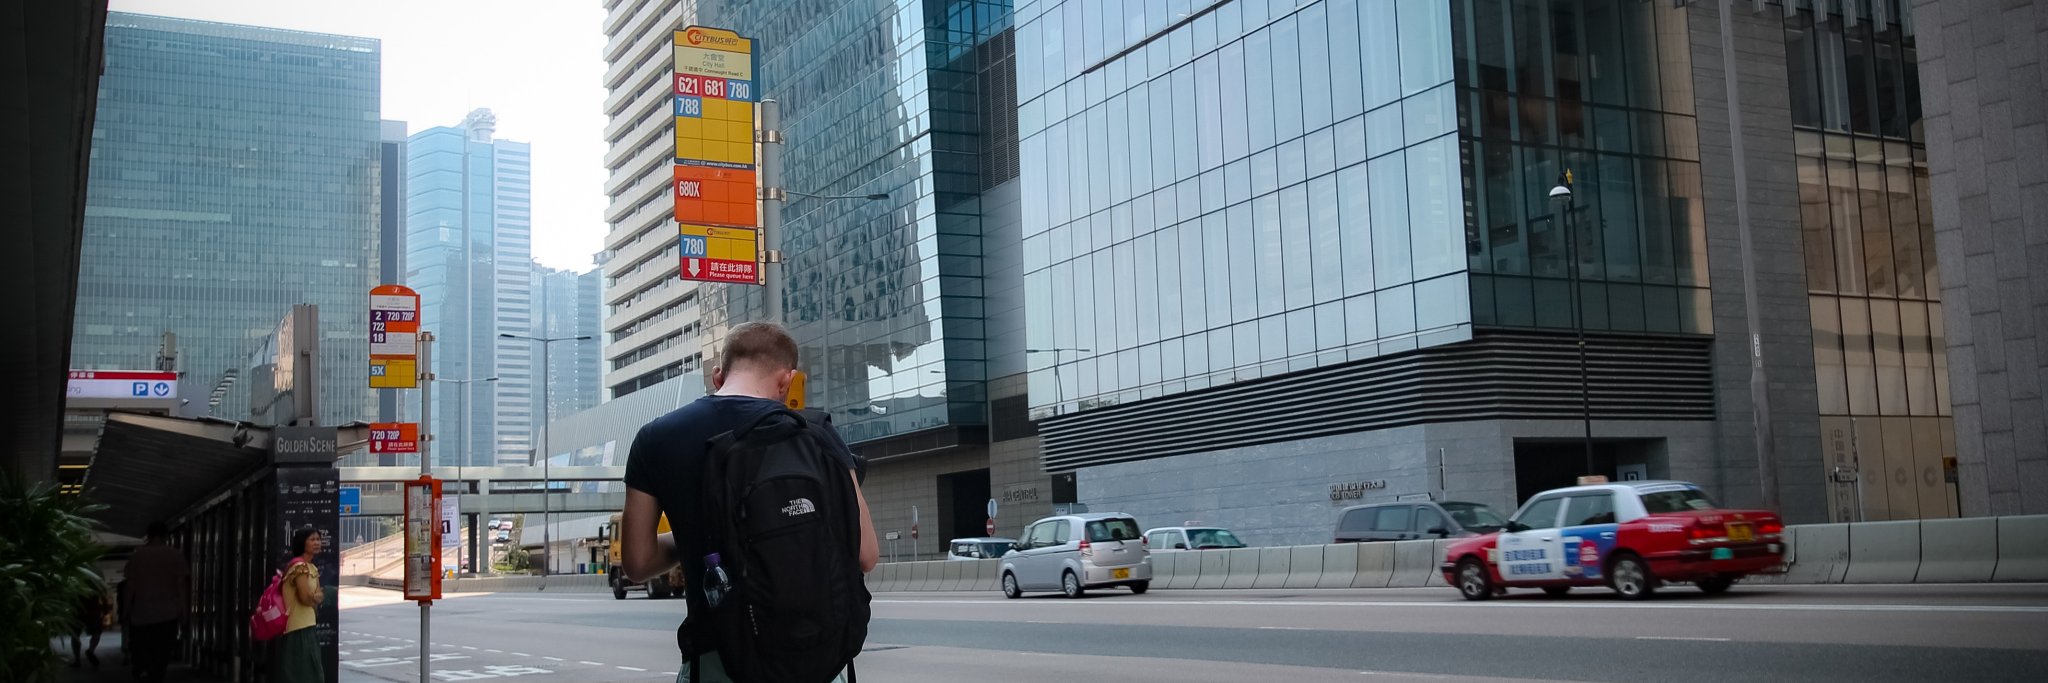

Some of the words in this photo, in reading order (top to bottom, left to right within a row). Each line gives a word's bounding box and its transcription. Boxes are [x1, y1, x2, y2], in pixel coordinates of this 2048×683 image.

[678, 77, 698, 94] 621
[704, 79, 724, 97] 681
[729, 82, 749, 99] 780
[678, 98, 699, 115] 788
[679, 180, 700, 197] 680X
[683, 238, 704, 255] 780
[710, 262, 752, 274] 請在此排隊
[375, 311, 382, 321] 2
[387, 311, 400, 321] 720
[401, 311, 415, 321] 720P
[372, 322, 385, 331] 722
[373, 333, 384, 342] 18
[371, 366, 385, 376] 5X
[371, 430, 385, 440] 720
[387, 430, 400, 440] 720P
[781, 504, 803, 513] NORTH
